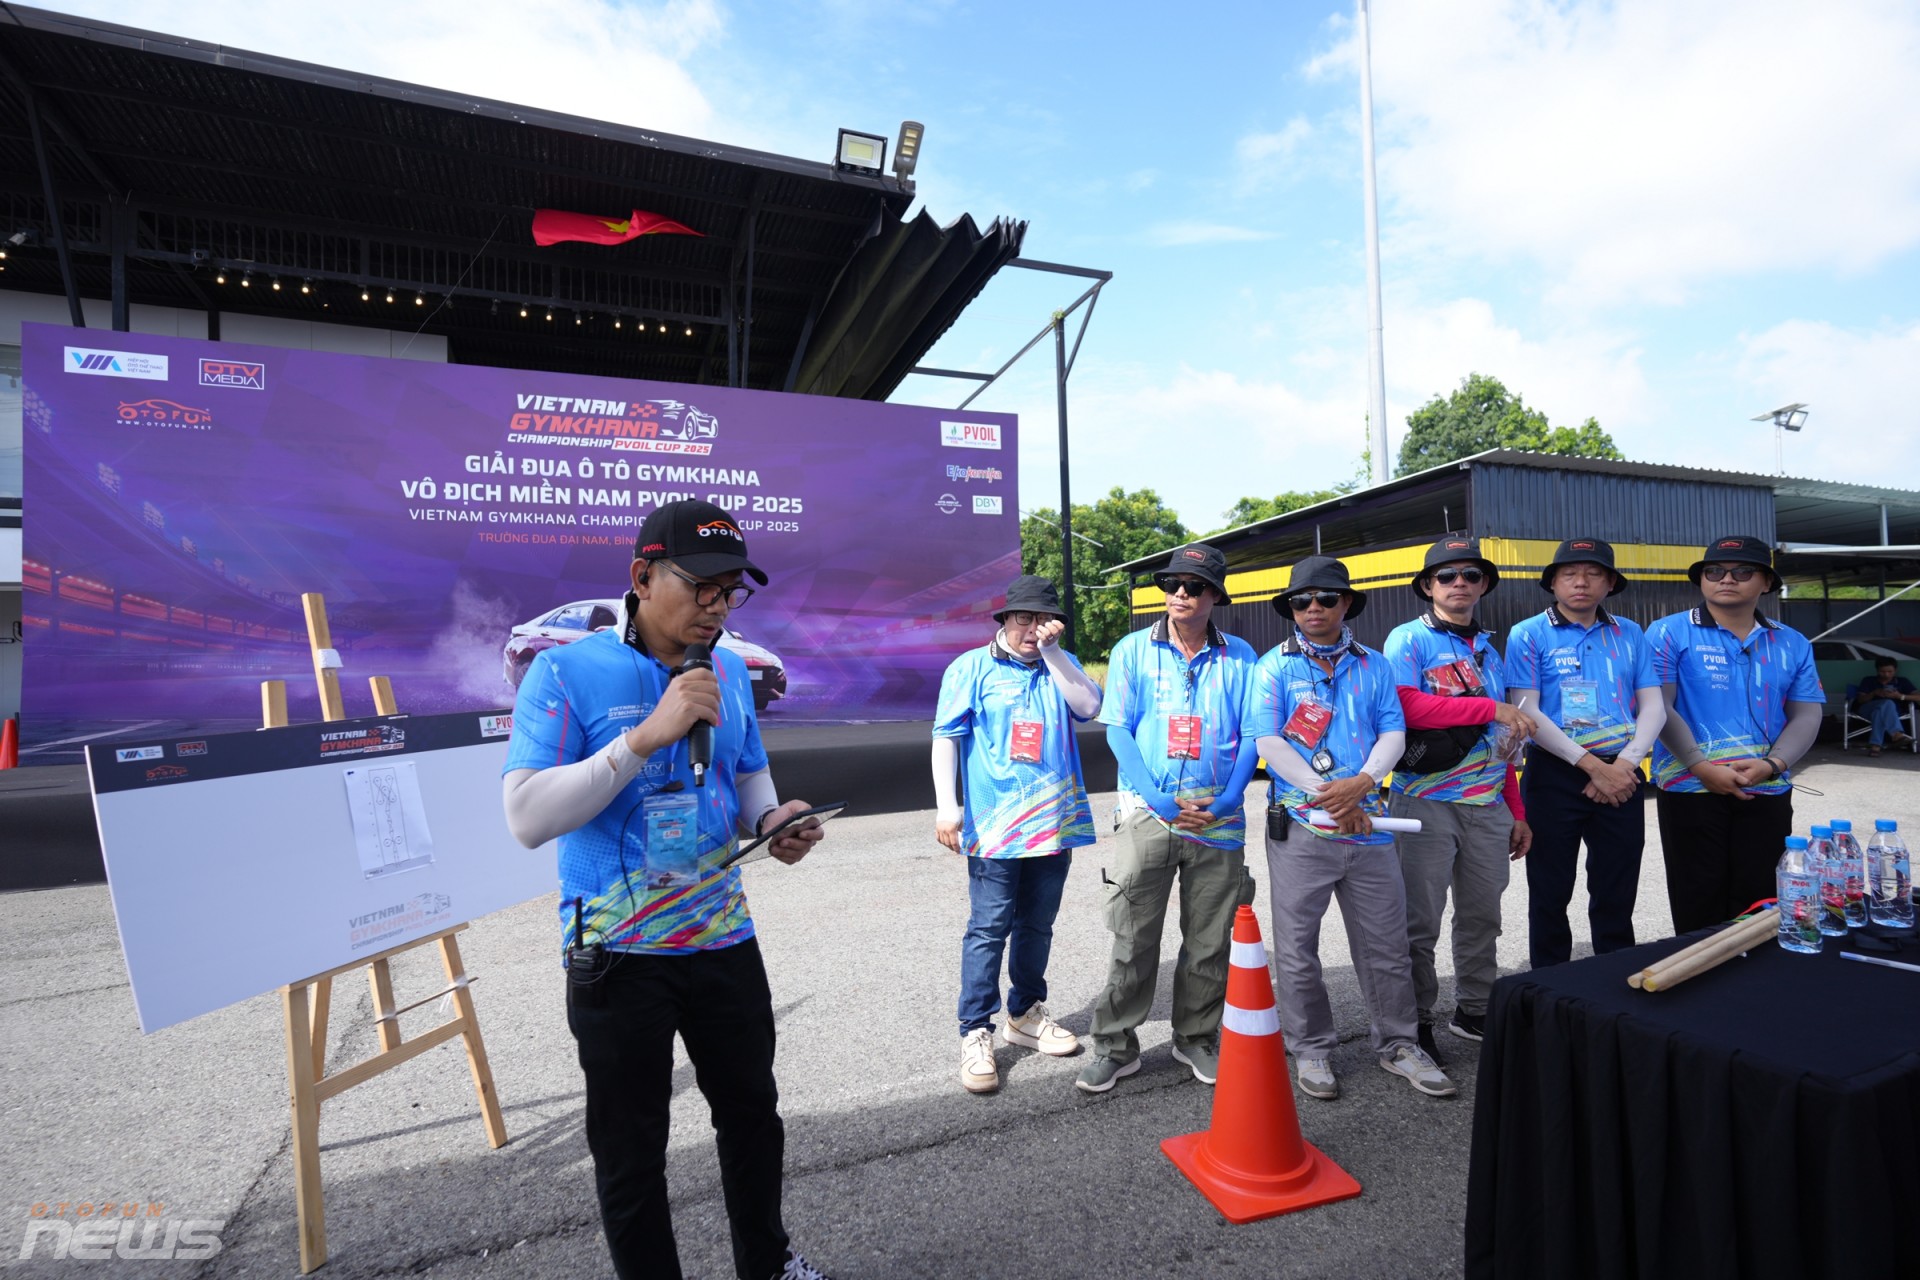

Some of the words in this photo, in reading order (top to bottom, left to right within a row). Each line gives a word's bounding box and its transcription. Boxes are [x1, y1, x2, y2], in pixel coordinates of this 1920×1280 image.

[204, 362, 260, 376] OTV
[204, 373, 260, 389] MEDIA
[516, 394, 626, 416] VIETNAM
[119, 407, 212, 424] OTOFUN
[116, 420, 212, 430] WWW.OTOFUN.NET
[510, 413, 658, 438] GYMKHANA
[964, 426, 997, 442] PVOIL
[507, 433, 612, 448] CHAMPIONSHIP
[614, 440, 652, 451] PVOIL
[655, 442, 680, 452] CUP
[684, 444, 710, 454] 2025
[464, 450, 514, 474] GIẢI
[520, 458, 572, 478] ĐUA
[578, 456, 594, 479] Ô
[600, 459, 630, 480] TÔ
[636, 464, 760, 486] GYMKHANA
[400, 476, 436, 499] VÔ
[444, 482, 501, 505] ĐỊCH
[510, 478, 570, 504] MIỀN
[578, 488, 631, 507] NAM
[752, 496, 803, 514] 2025
[409, 508, 482, 522] VIETNAM
[488, 511, 576, 525] GYMKHANA
[738, 520, 763, 531] CUP
[767, 521, 799, 532] 2025
[478, 530, 528, 544] TRƯỜNG
[532, 534, 557, 544] ĐUA
[642, 543, 666, 553] PVOIL
[1703, 654, 1728, 665] PVOIL
[321, 730, 367, 741] VIETNAM
[320, 737, 382, 752] GYMKHANA
[349, 904, 404, 928] VIETNAM
[350, 910, 424, 942] GYMKHANA
